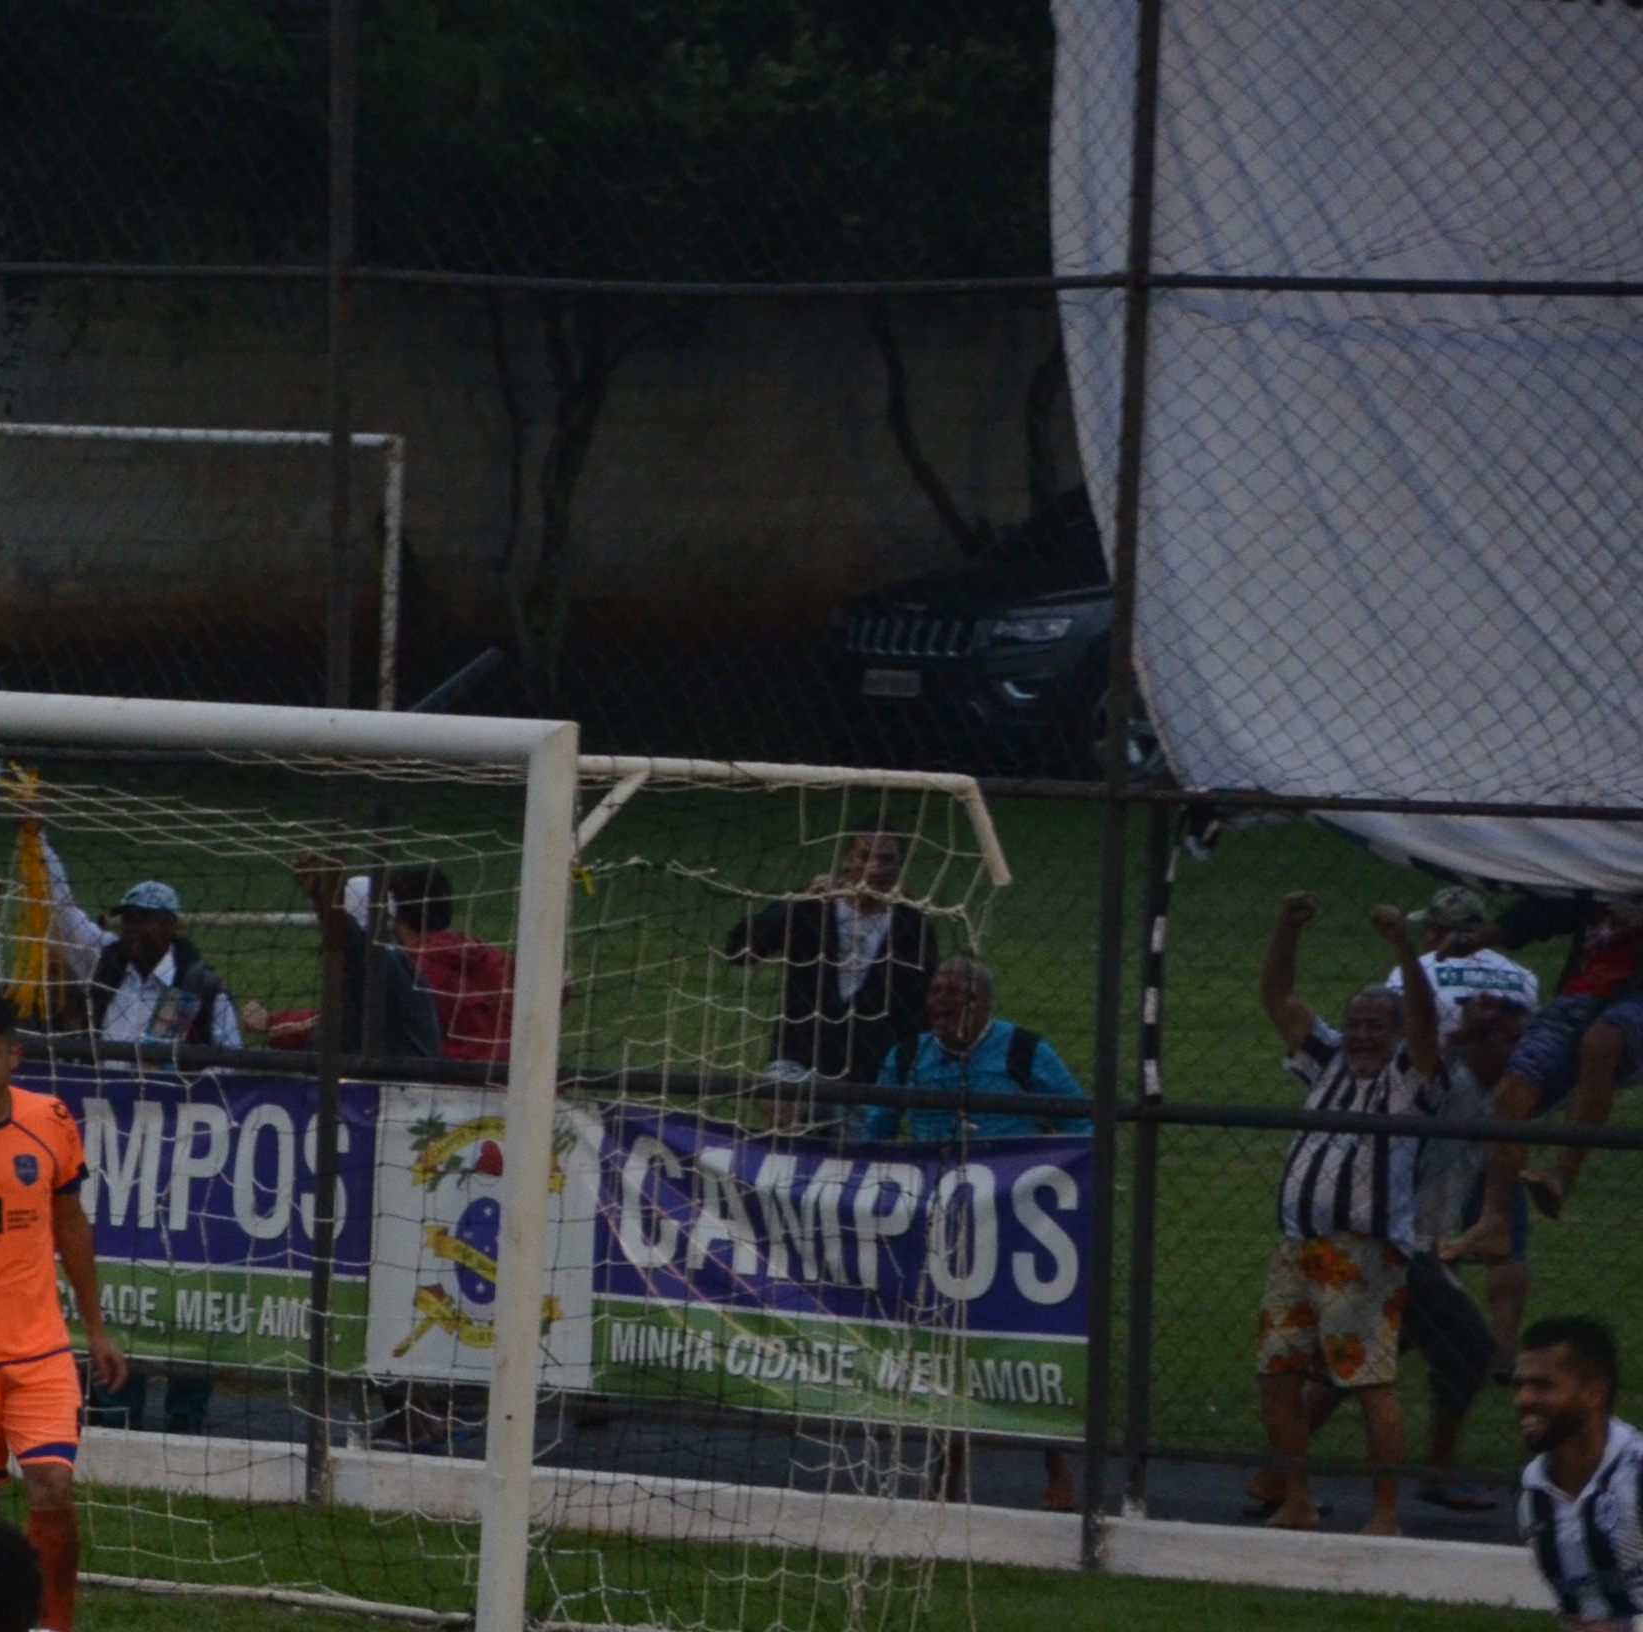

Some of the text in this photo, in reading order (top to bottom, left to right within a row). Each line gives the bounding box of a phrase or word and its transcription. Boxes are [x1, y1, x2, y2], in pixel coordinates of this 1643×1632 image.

[79, 1096, 351, 1241] MPOS
[620, 1133, 1080, 1305] CAMPOS
[175, 1289, 248, 1335] MEU
[257, 1294, 342, 1343] AMO.
[610, 1322, 1075, 1406] MINHA CIDADE, MEU AMOR.
